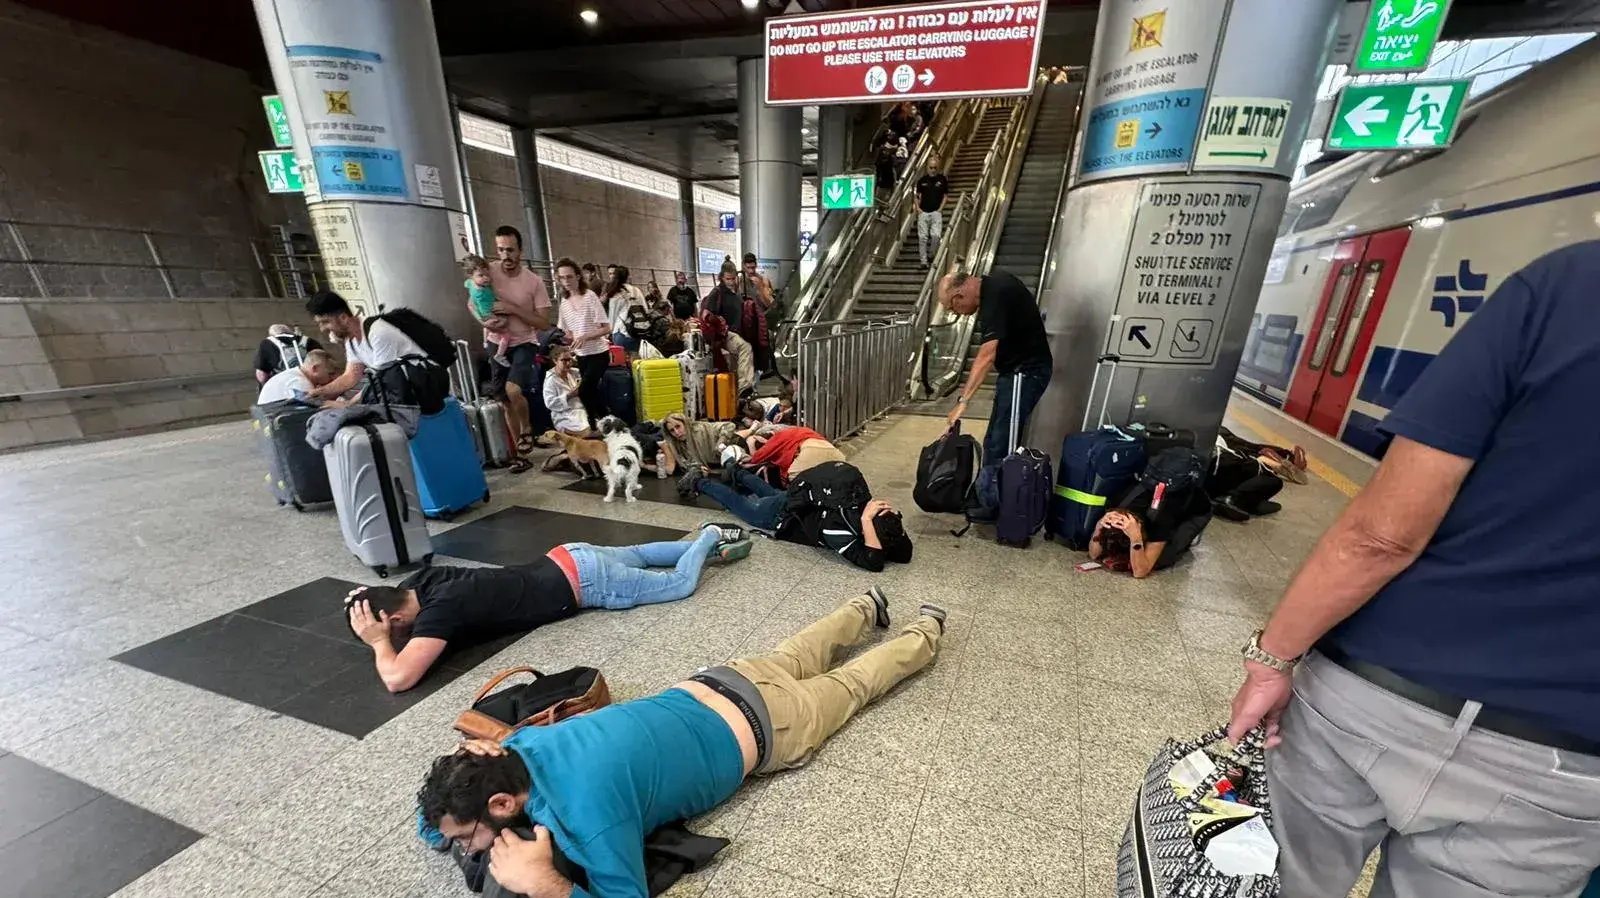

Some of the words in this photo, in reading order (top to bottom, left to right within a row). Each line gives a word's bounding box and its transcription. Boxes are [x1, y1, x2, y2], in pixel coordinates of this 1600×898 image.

[907, 14, 945, 28] כבודה
[947, 11, 969, 26] עם
[971, 4, 1015, 24] לעלות
[1016, 5, 1038, 24] אין
[820, 16, 878, 36] להשתמש
[879, 17, 896, 31] נא
[770, 24, 819, 40] במעליות
[770, 45, 784, 56] DO
[785, 43, 806, 55] NOT
[805, 42, 821, 54] GO
[821, 41, 836, 53] UP
[837, 39, 857, 51] THE
[857, 34, 917, 49] ESCALATOR
[918, 29, 973, 46] CARRYING
[973, 26, 1029, 41] LUGGAGE
[1374, 33, 1419, 50] יציאה
[824, 53, 862, 66] PLEASE
[862, 51, 884, 63] USE
[884, 48, 905, 62] THE
[905, 45, 967, 61] ELEVATORS
[1135, 61, 1150, 73] THE
[1151, 52, 1199, 70] ESCALATOR
[1369, 51, 1391, 61] EXIT
[1139, 72, 1176, 88] LUGGAGE
[1122, 95, 1171, 116] להשתמש
[1175, 96, 1191, 108] נא
[1203, 105, 1239, 142] מוגן
[1237, 104, 1288, 138] למרחב
[1119, 152, 1134, 162] THE
[1135, 147, 1184, 161] ELEVATORS
[1149, 193, 1181, 207] פנימי
[1184, 193, 1220, 208] הסעה
[1222, 193, 1252, 208] שרות
[720, 214, 727, 228] 1
[1168, 213, 1174, 226] 1
[1178, 209, 1227, 226] לטרמינל
[1150, 232, 1160, 245] 2
[1165, 229, 1204, 245] מפלס
[1209, 232, 1232, 250] דרך
[1189, 256, 1234, 271] SERVICE
[1139, 273, 1154, 287] TO
[1157, 274, 1214, 288] TERMINAL
[1216, 276, 1223, 288] 1
[1137, 291, 1160, 305] VIA
[1165, 292, 1203, 306] LEVEL
[1207, 293, 1216, 306] 2
